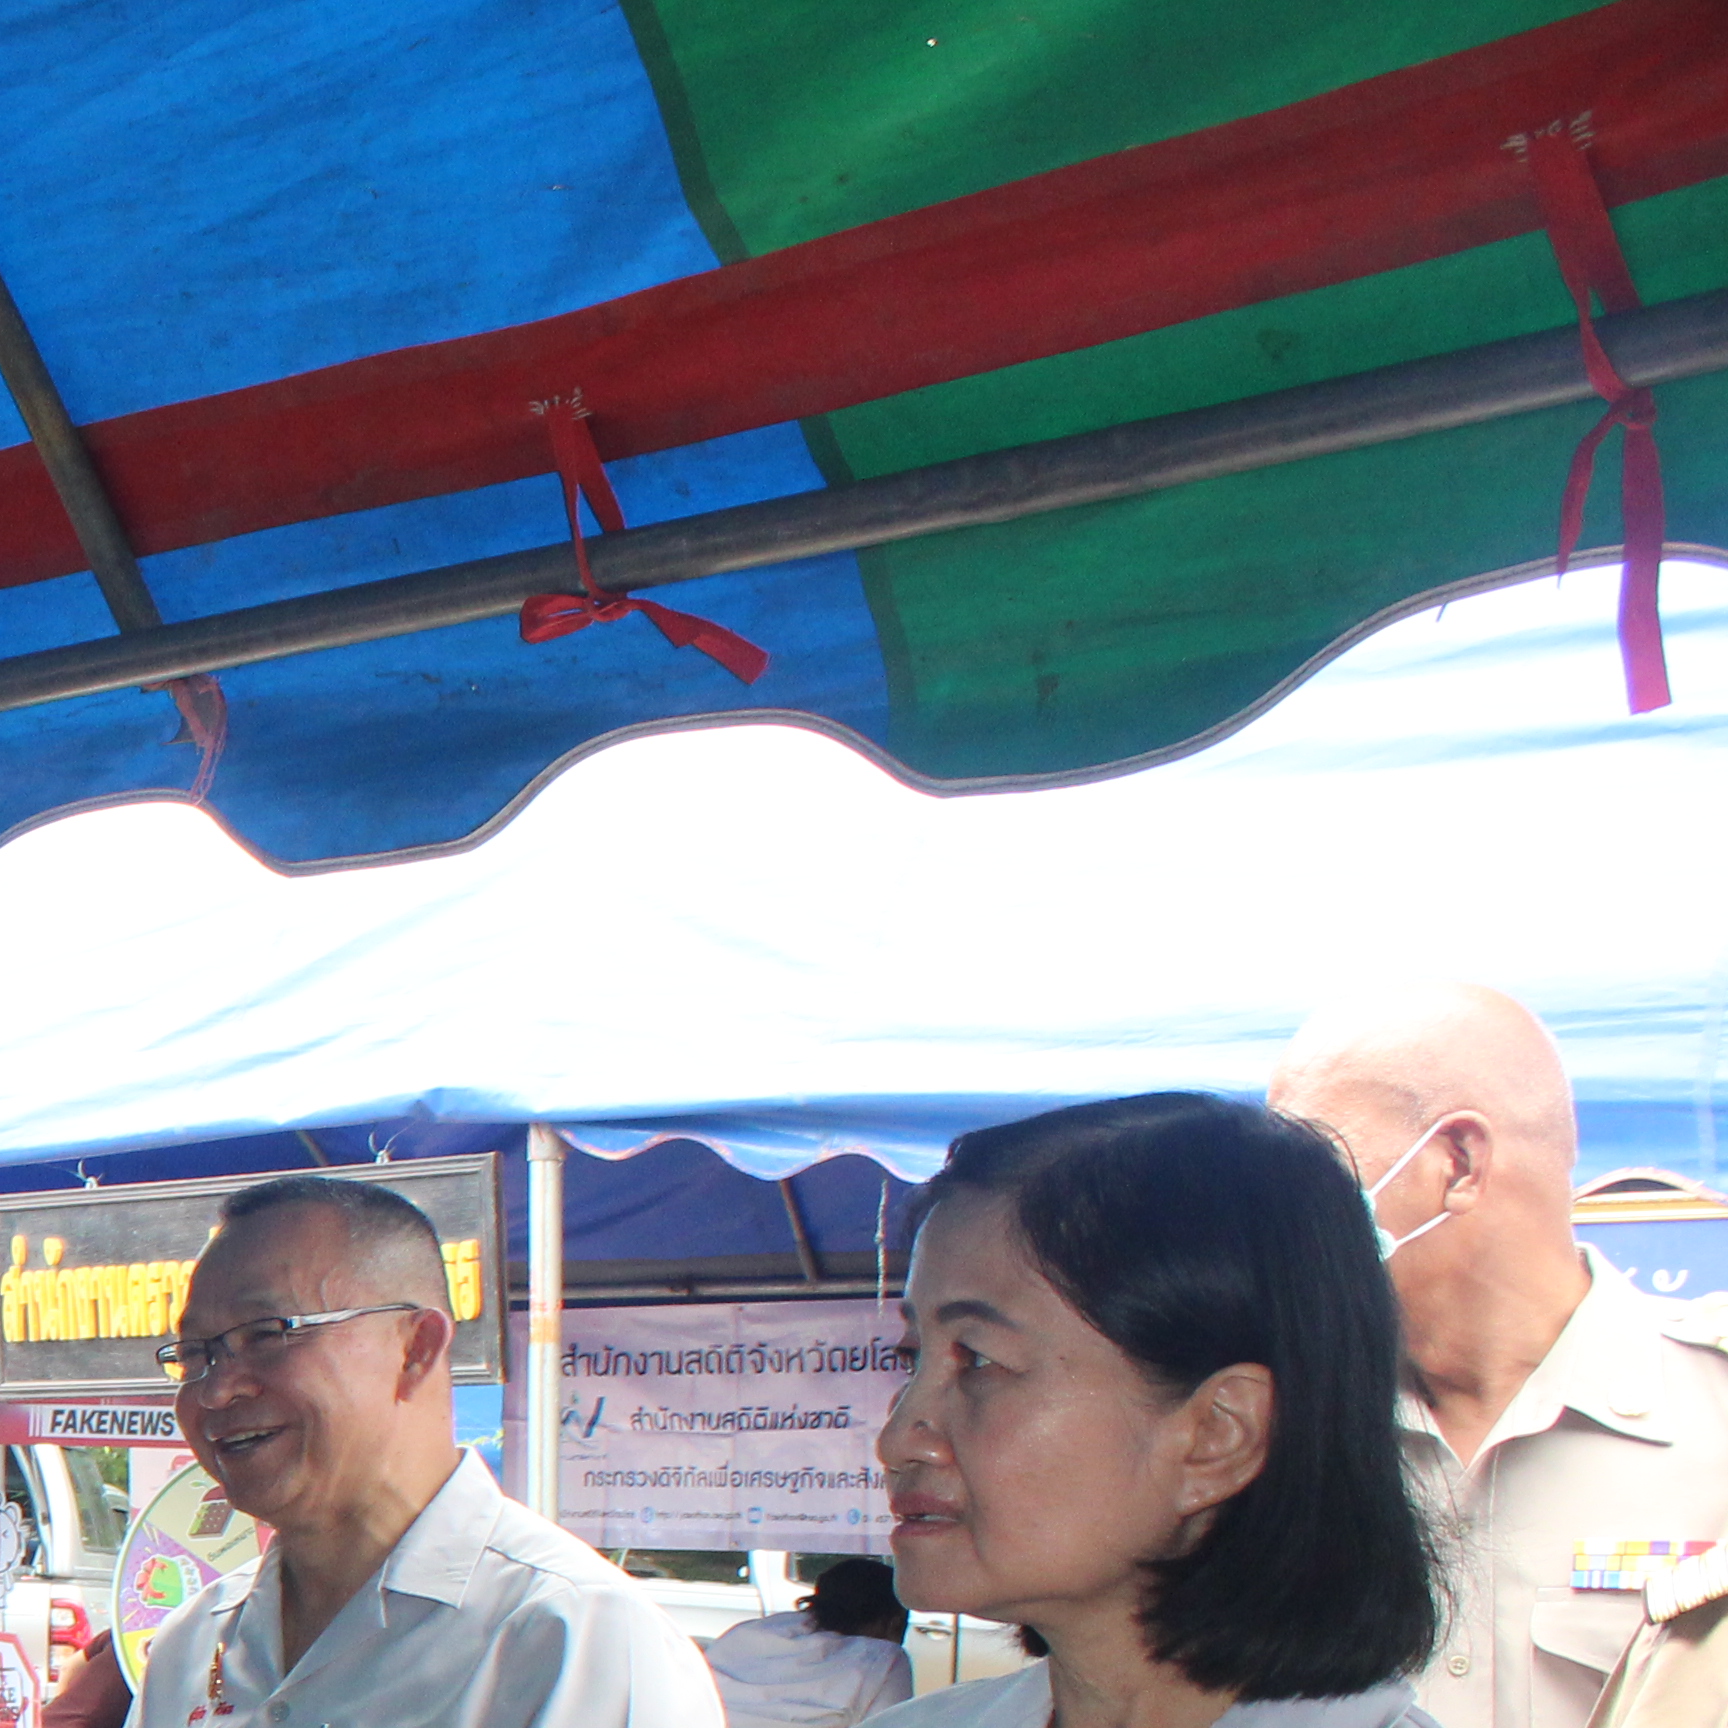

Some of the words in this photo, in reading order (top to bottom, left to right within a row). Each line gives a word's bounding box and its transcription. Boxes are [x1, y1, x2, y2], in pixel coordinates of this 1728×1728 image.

[561, 1336, 912, 1378] สำนักงานสถิติจังหวัดยโส
[49, 1408, 176, 1437] FAKENEWS
